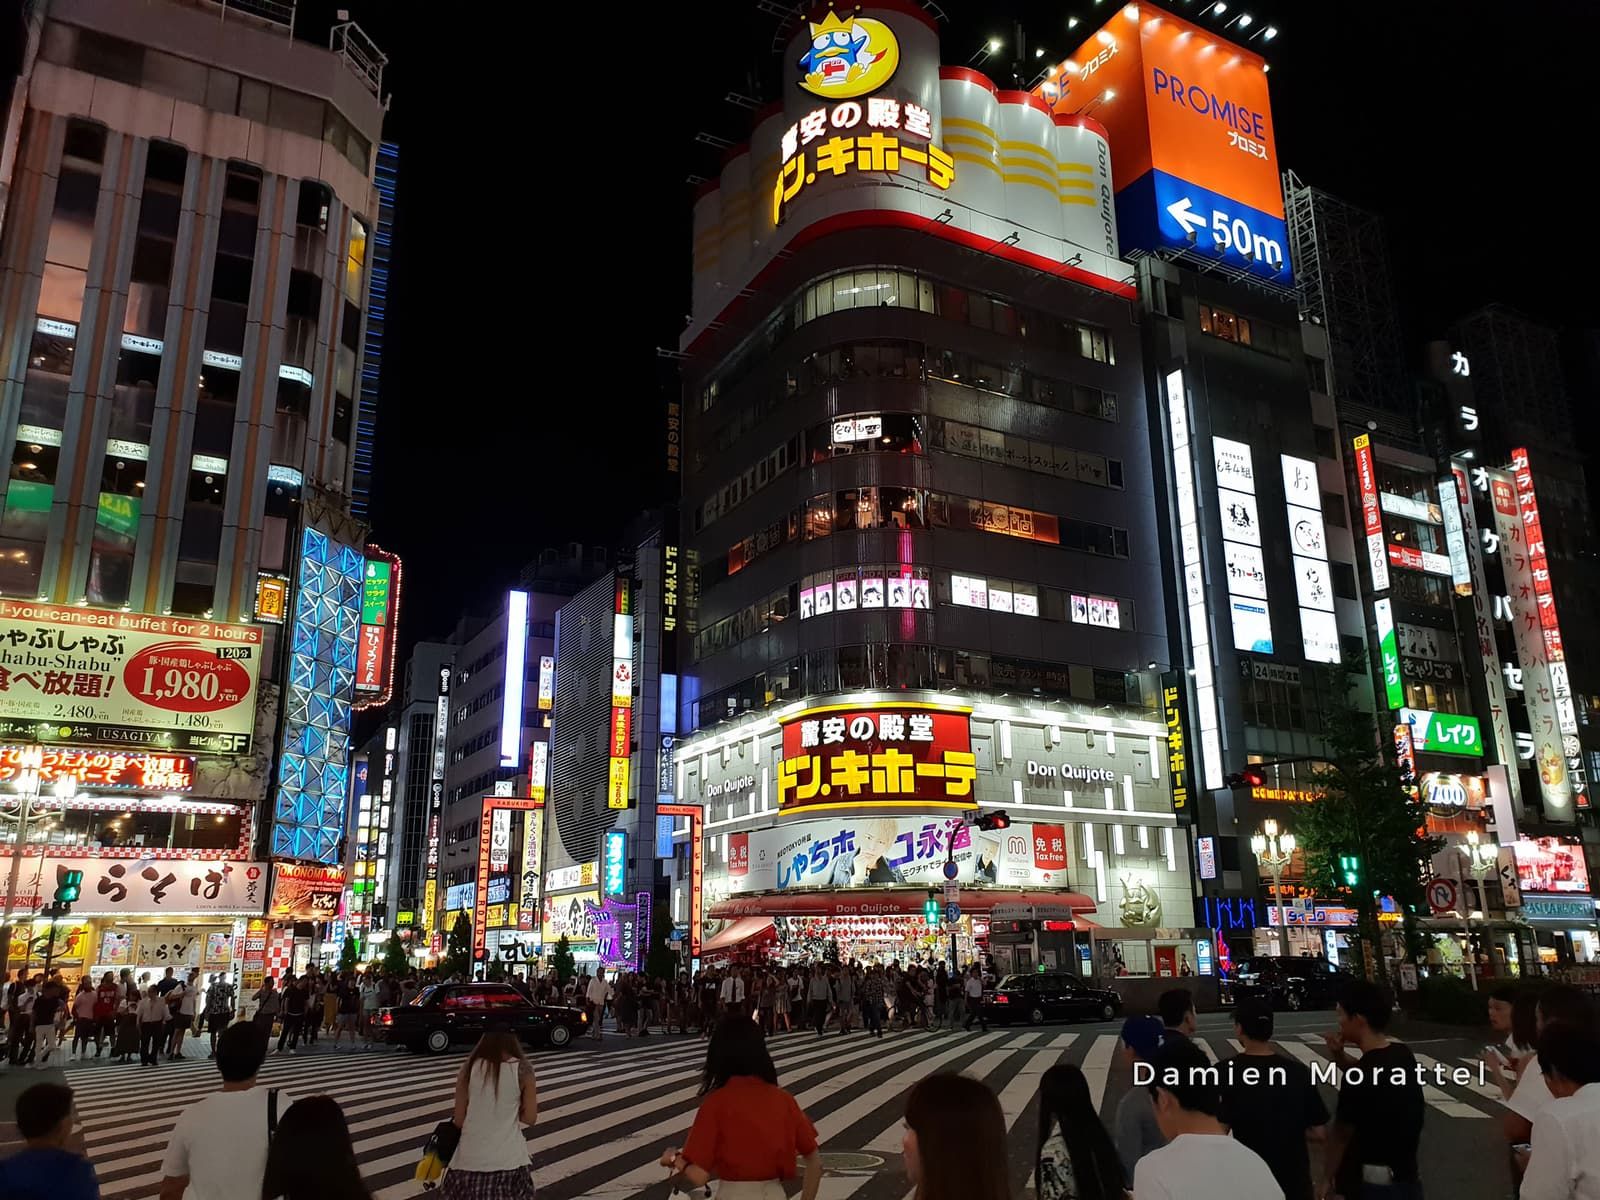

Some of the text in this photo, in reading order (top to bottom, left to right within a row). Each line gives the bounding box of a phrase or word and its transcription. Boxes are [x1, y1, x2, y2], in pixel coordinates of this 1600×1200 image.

[1081, 40, 1120, 82] プロミス
[1152, 68, 1267, 141] PROMISE
[1227, 131, 1269, 161] プロミス
[1097, 139, 1115, 256] Don Quijote
[1212, 209, 1284, 269] 50m
[0, 628, 126, 655] ゃぶしゃぶ
[119, 615, 167, 632] buffet
[172, 621, 194, 635] for
[199, 624, 210, 636] 2
[214, 625, 258, 641] hours
[219, 648, 249, 659] 120分
[139, 667, 219, 701] 1,980
[1384, 652, 1399, 686] レイク
[102, 730, 162, 743] USAGIYA
[801, 714, 935, 748] 驚安の殿堂
[1435, 721, 1476, 746] レイク
[707, 774, 754, 797] Don Quijote
[1027, 760, 1115, 782] Don Quijote
[610, 835, 622, 891] カラオケ
[1036, 852, 1064, 862] Tax Free
[280, 865, 347, 881] OKONOMI YAKI
[477, 820, 490, 935] GODZILLA ROAD
[836, 903, 900, 914] Don Quijote
[624, 921, 633, 959] カラオケ
